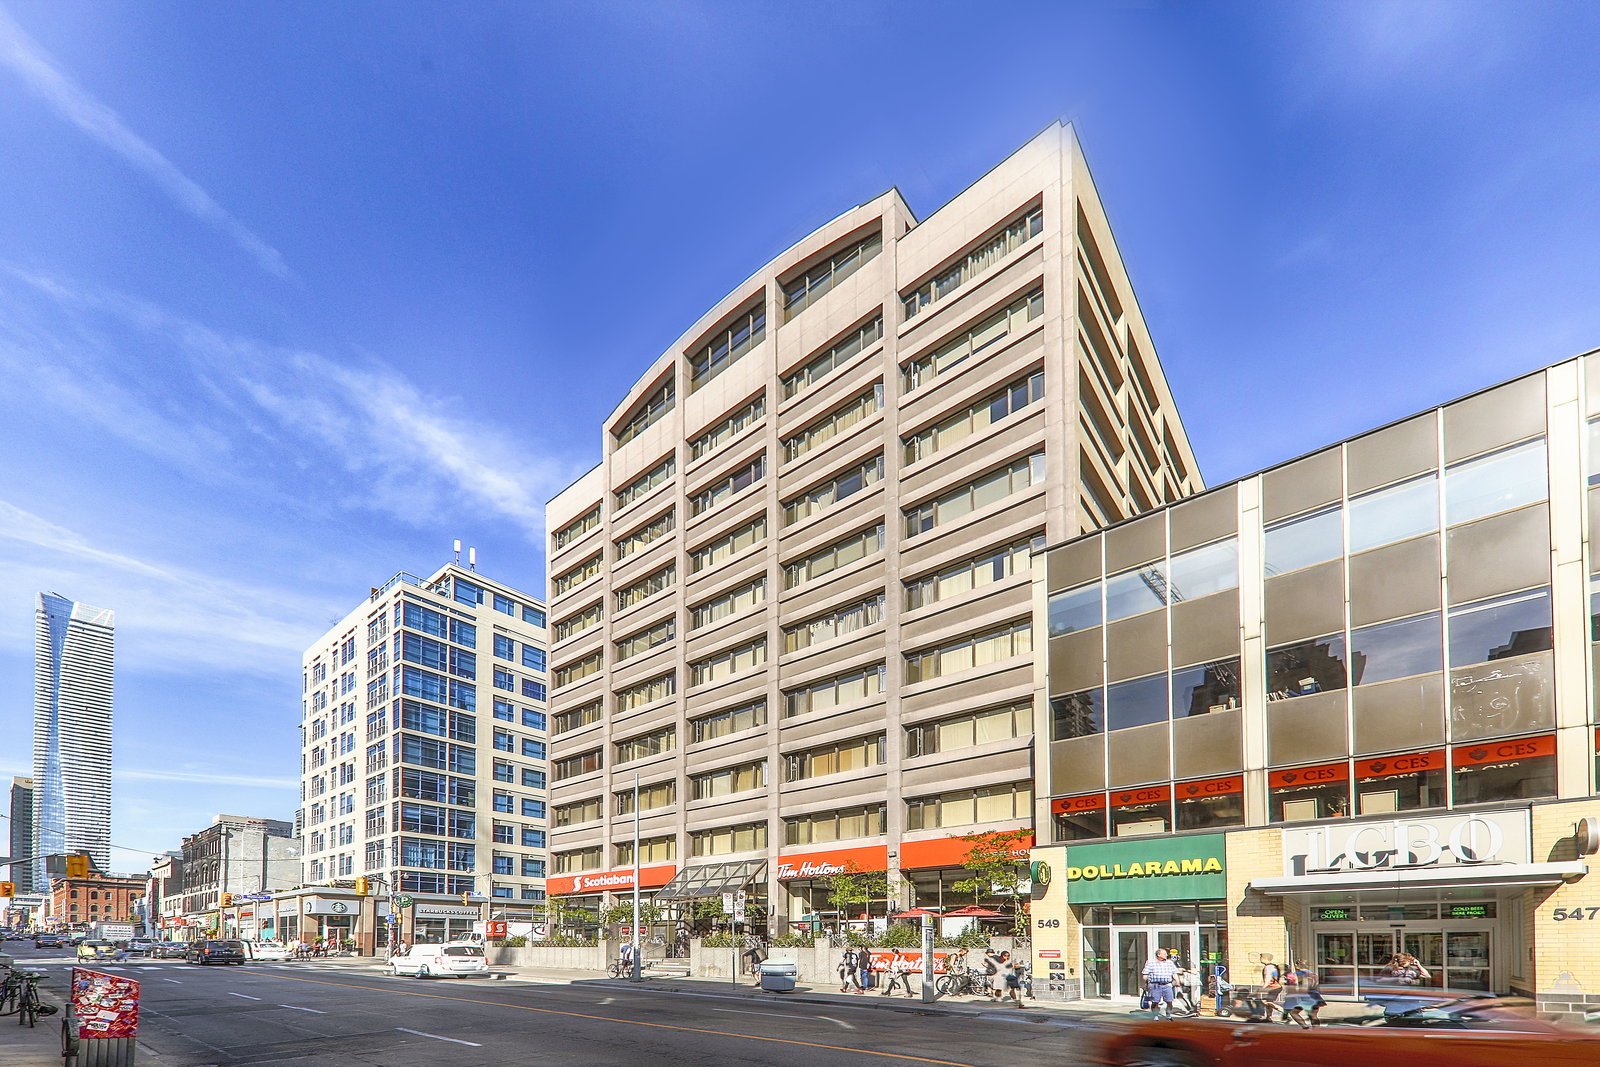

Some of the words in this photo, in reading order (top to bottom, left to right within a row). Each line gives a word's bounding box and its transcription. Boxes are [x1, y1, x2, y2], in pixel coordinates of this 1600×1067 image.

[1495, 742, 1537, 758] CES
[1393, 756, 1430, 771] CES
[1303, 768, 1336, 781] CES
[1204, 781, 1232, 793] CES
[1136, 789, 1161, 801] CES
[1074, 798, 1097, 808] CES
[1305, 818, 1504, 872] LCBO
[778, 864, 799, 878] Tim
[799, 862, 846, 877] Hortons
[1067, 857, 1223, 881] DOLLARAMA
[584, 872, 636, 888] Scotiaban
[1553, 907, 1600, 921] 547
[1037, 919, 1060, 928] 549
